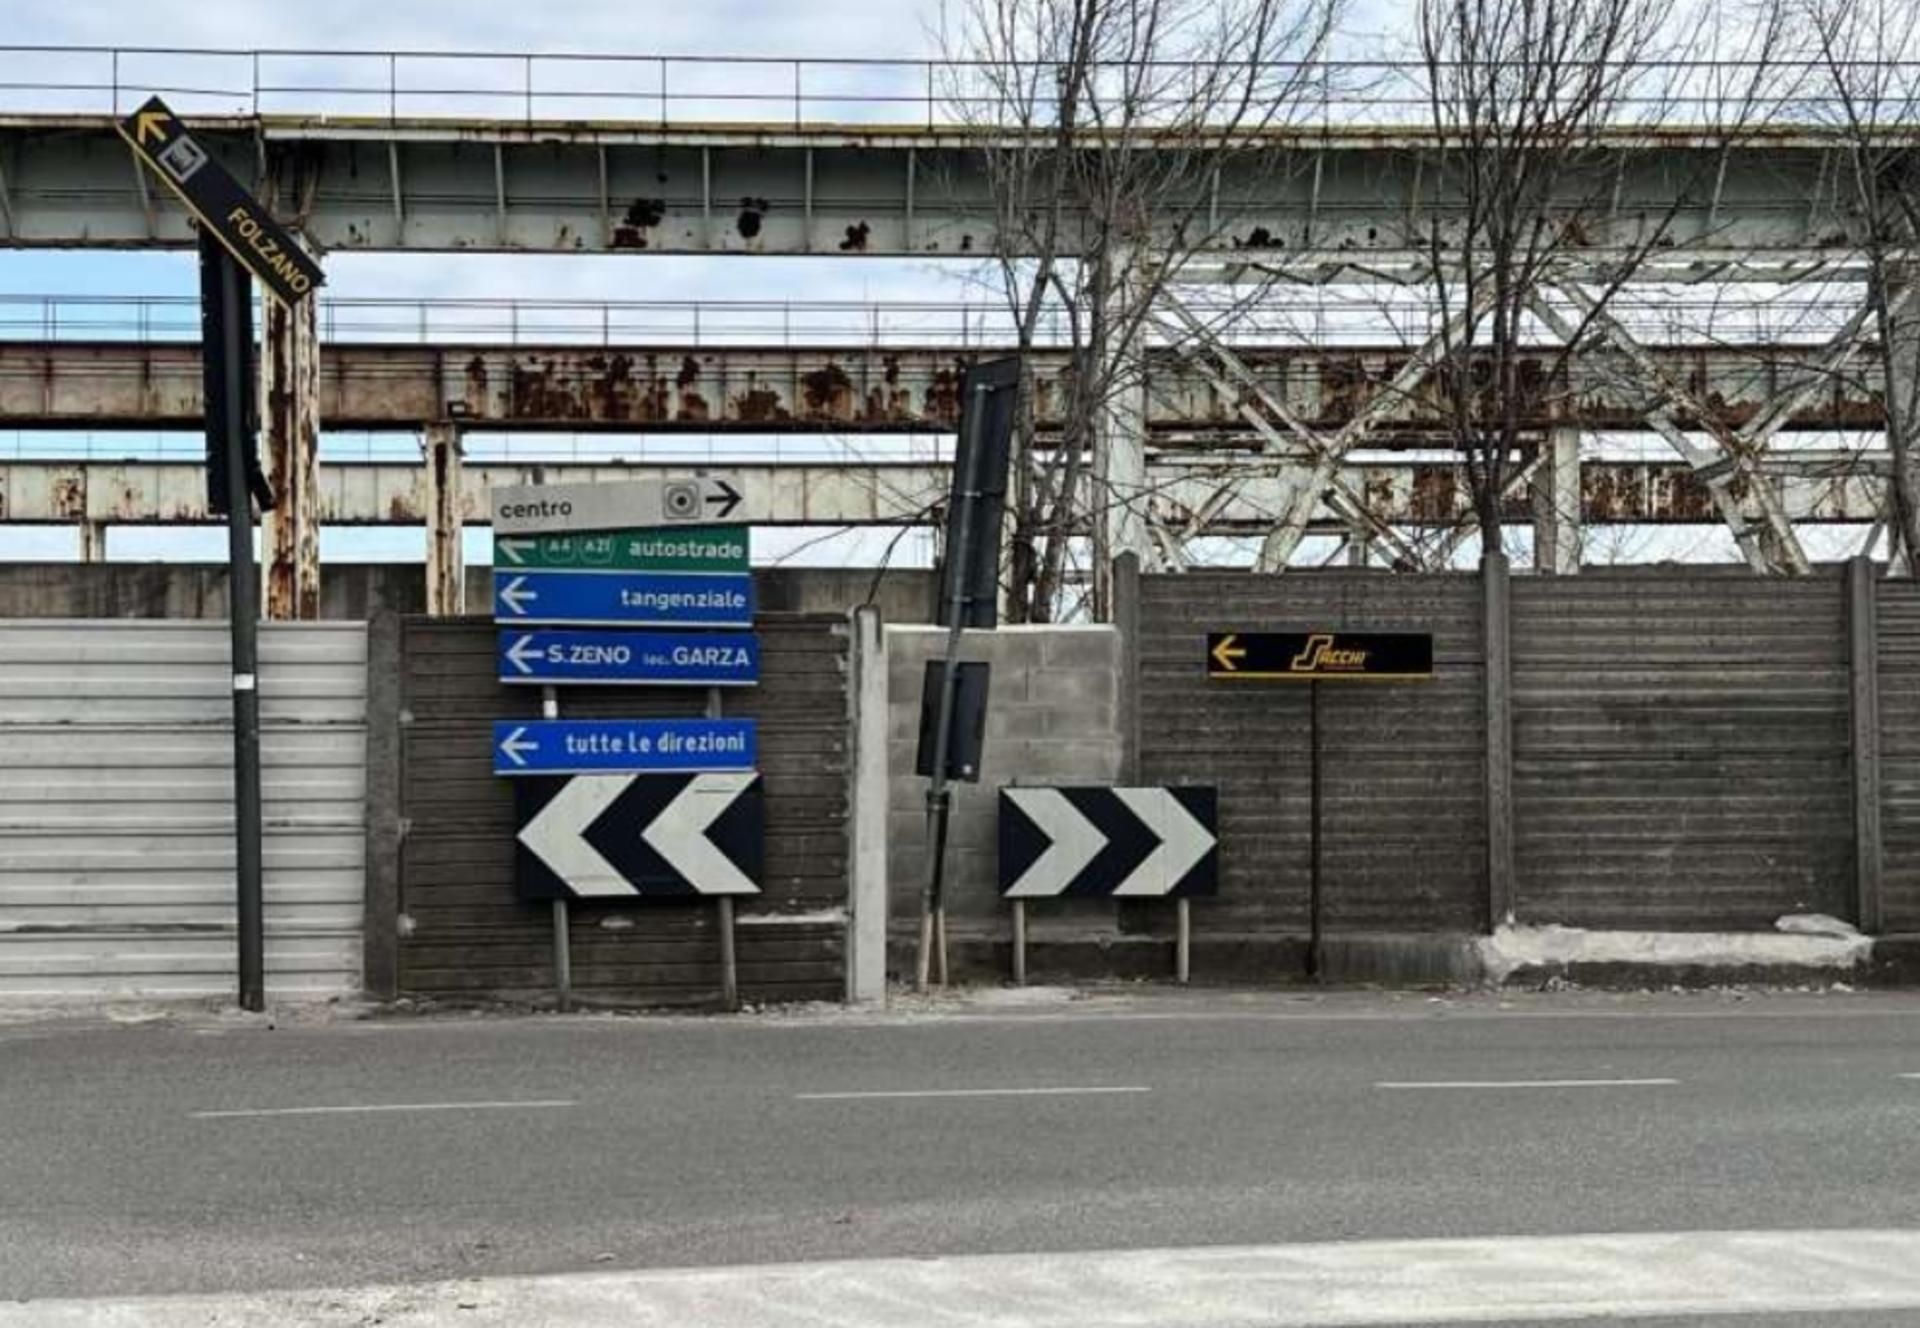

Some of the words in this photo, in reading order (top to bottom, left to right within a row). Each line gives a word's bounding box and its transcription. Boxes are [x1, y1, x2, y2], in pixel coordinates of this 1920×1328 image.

[227, 207, 310, 293] FOLZANO
[500, 500, 572, 518] centro
[629, 539, 744, 559] autostrade
[621, 588, 747, 611] tangenziale
[548, 644, 631, 664] S.ZENO
[672, 647, 750, 667] GARZA
[566, 733, 623, 754] tutte
[629, 732, 651, 753] le
[657, 730, 746, 753] direzioni
